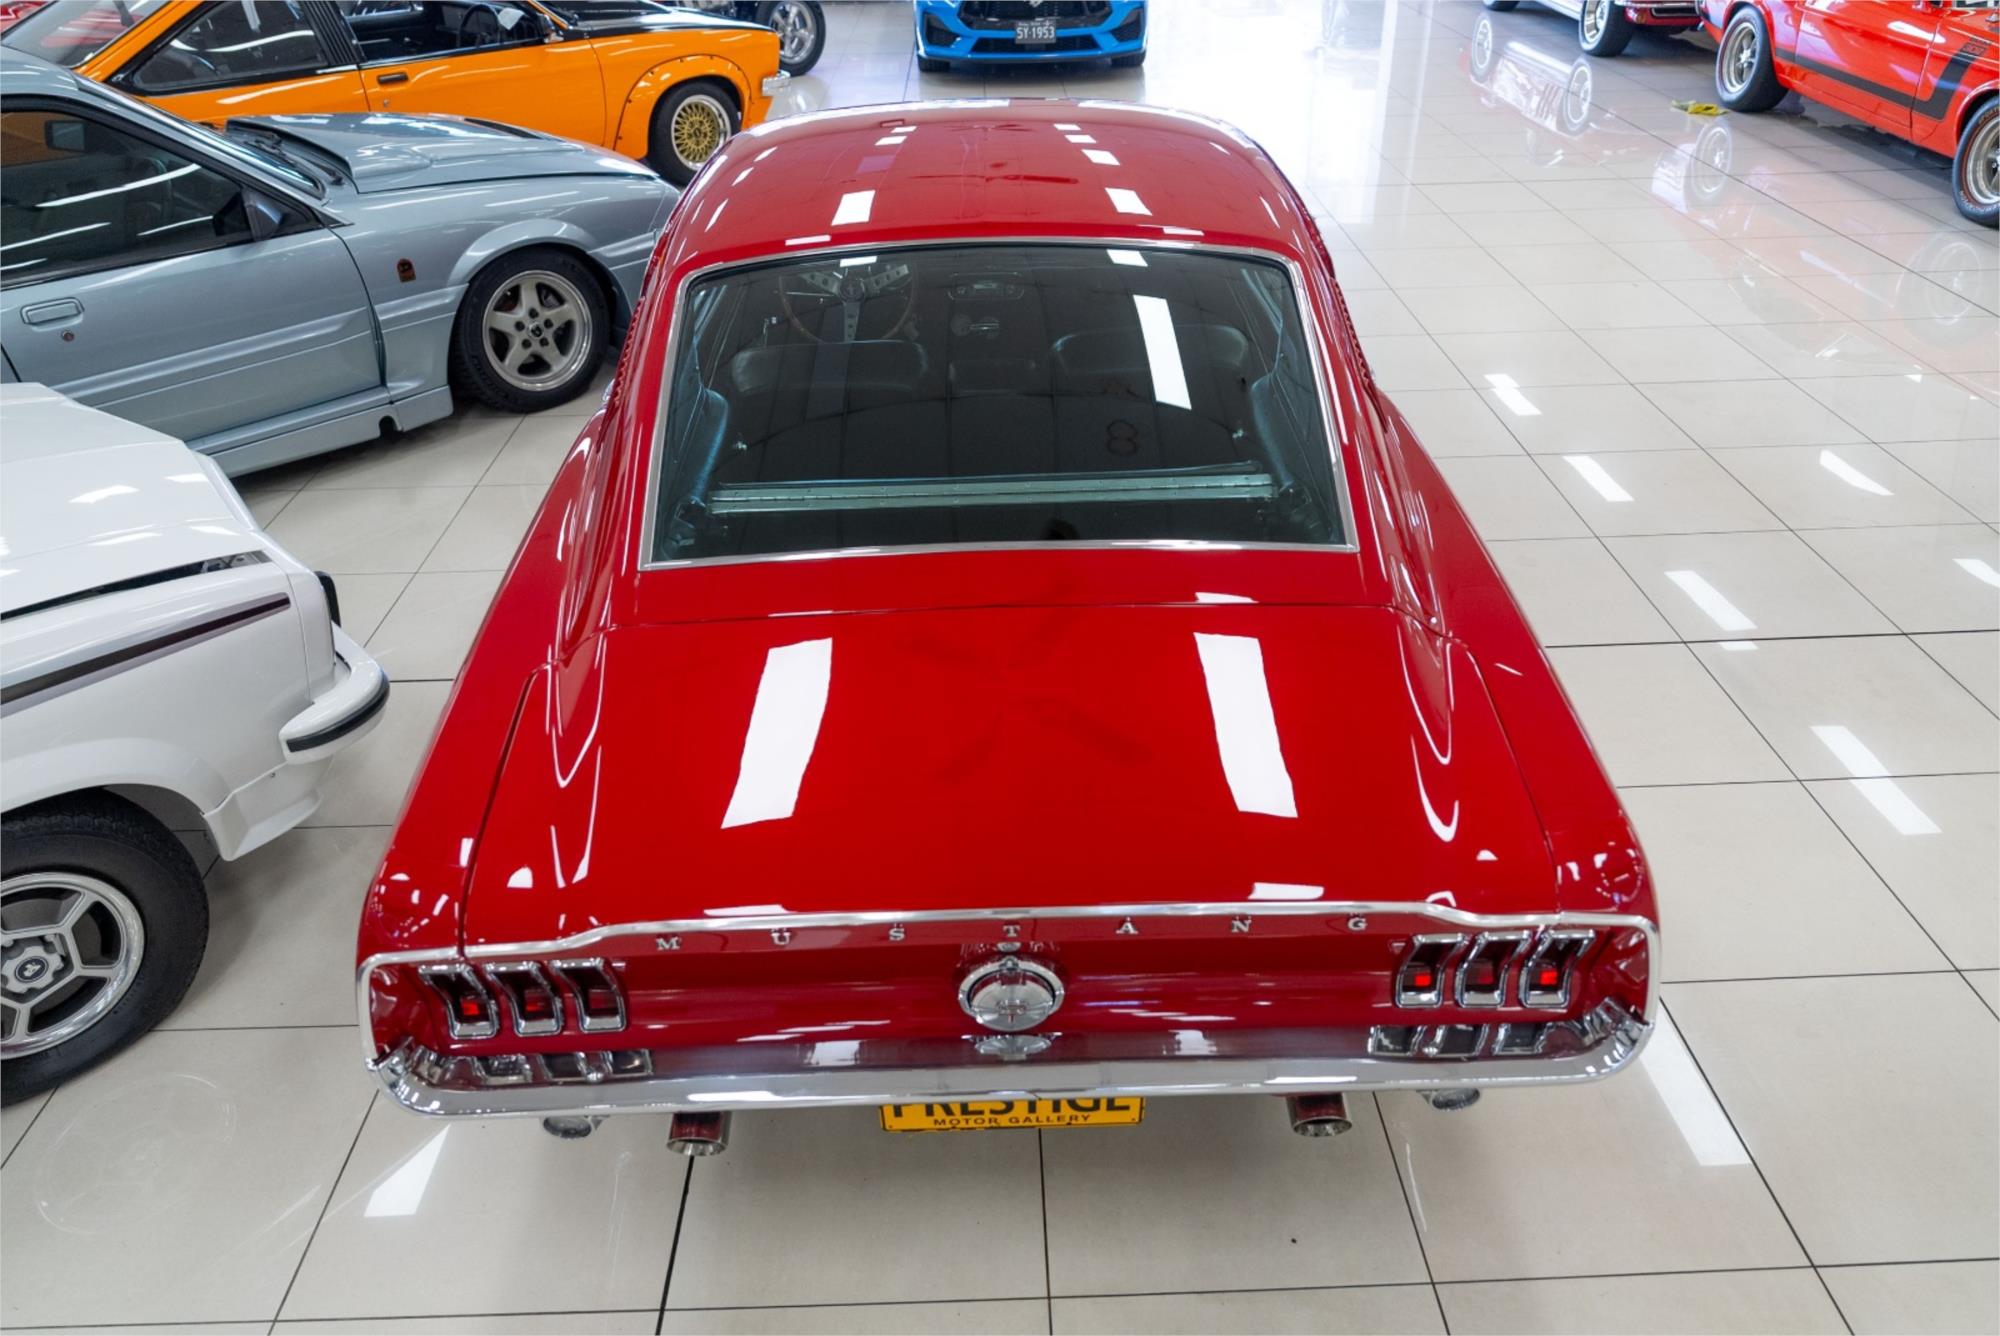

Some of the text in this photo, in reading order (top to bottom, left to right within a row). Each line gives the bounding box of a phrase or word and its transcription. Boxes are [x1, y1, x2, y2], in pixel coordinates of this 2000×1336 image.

[656, 914, 1367, 951] MUSTANG
[933, 1114, 1091, 1127] MOTOR GALLERY
